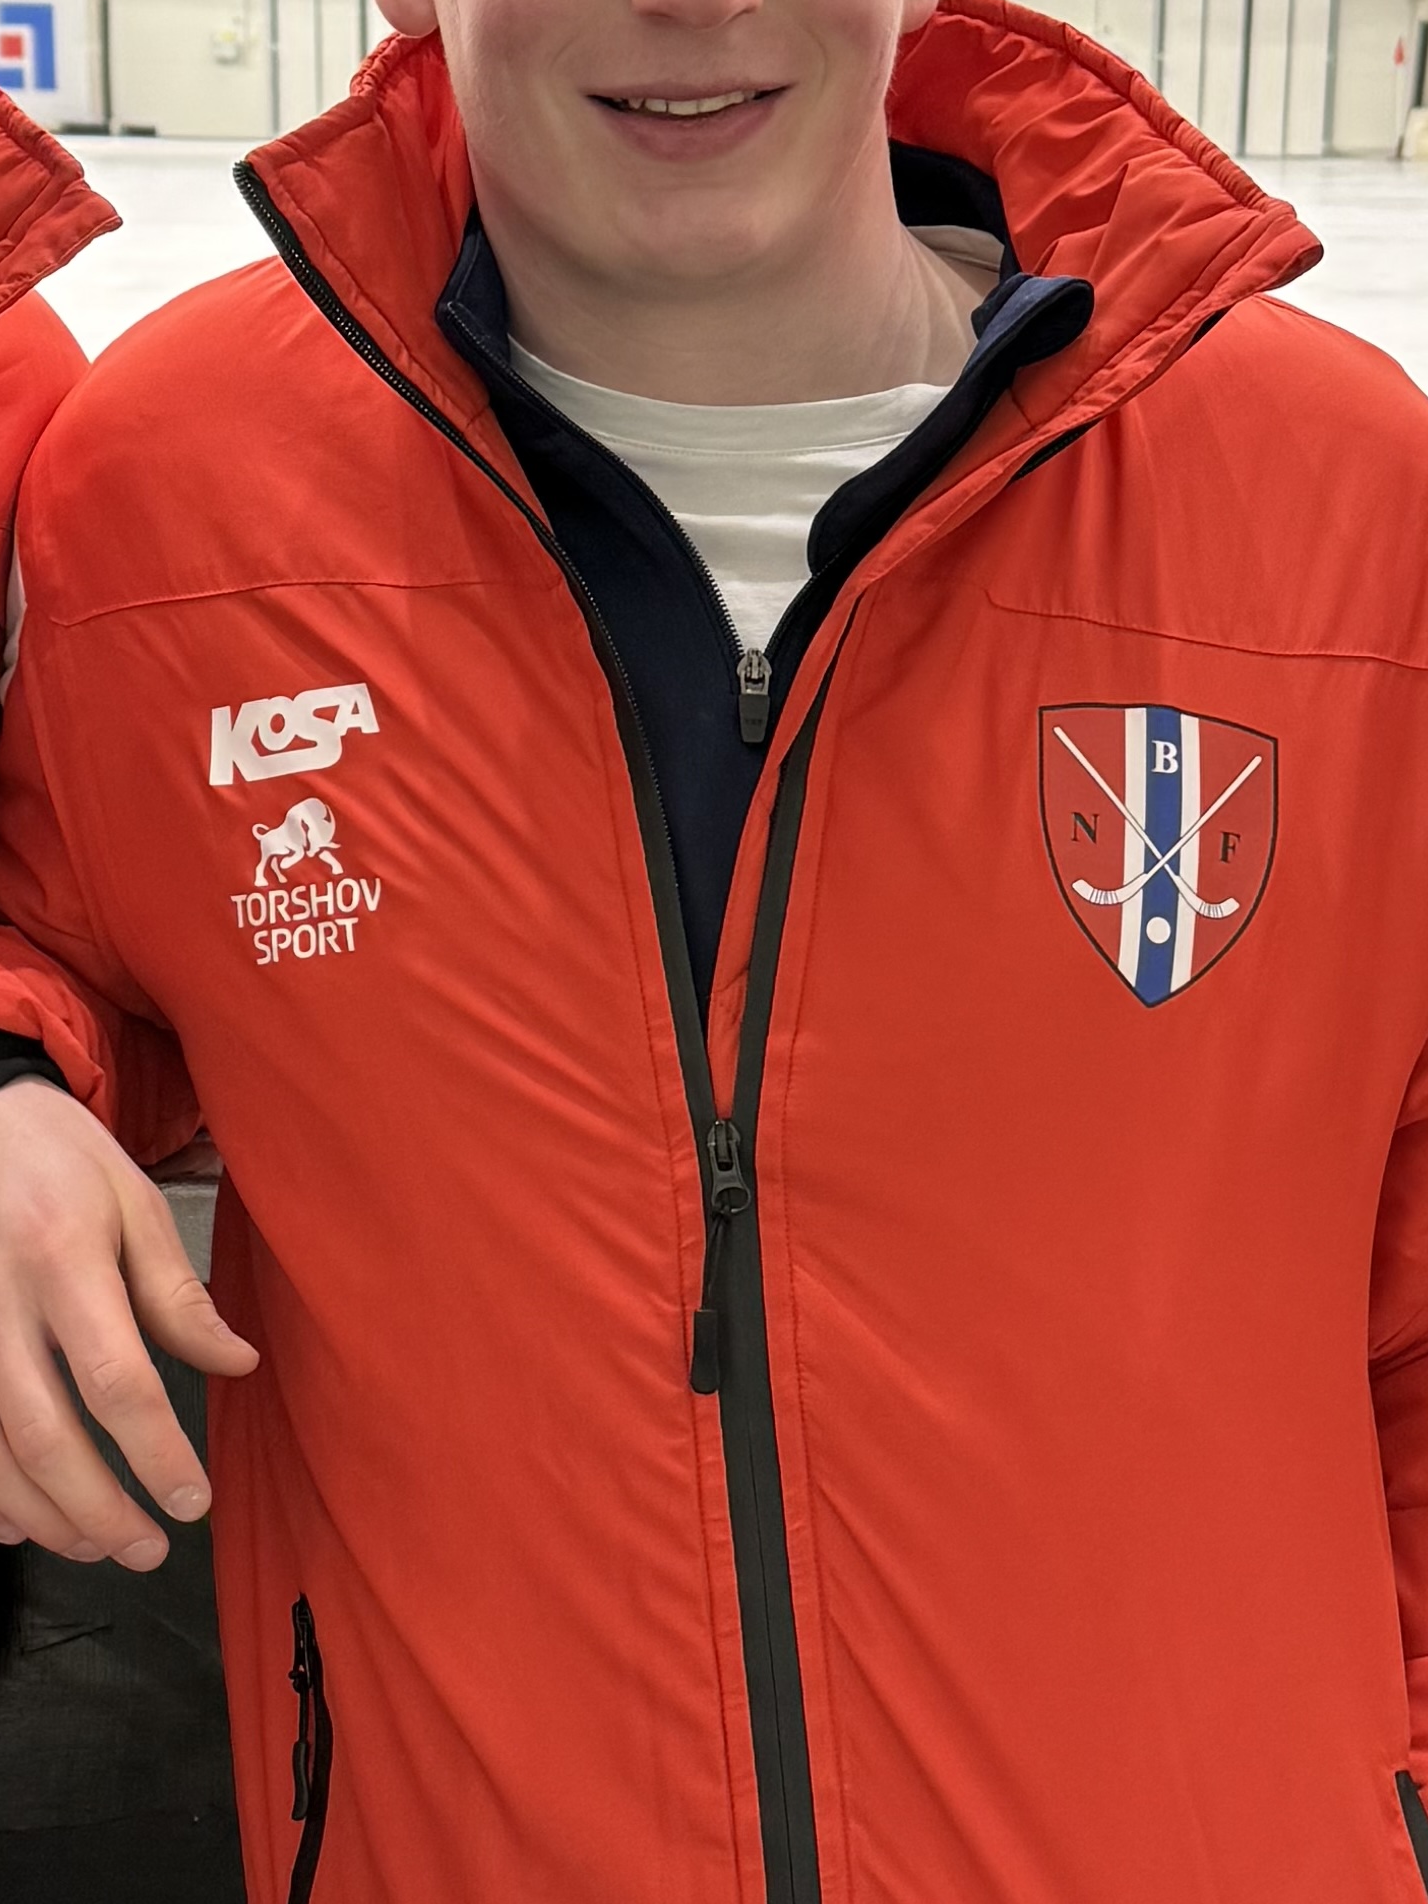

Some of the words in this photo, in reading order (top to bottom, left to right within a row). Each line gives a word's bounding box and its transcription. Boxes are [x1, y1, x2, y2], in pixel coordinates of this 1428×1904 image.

[209, 682, 380, 786] KOSA
[1151, 740, 1179, 774] B
[1071, 811, 1101, 844] N
[1220, 830, 1241, 864] F
[230, 877, 381, 928] TORSHOV
[253, 917, 359, 965] SPORT
